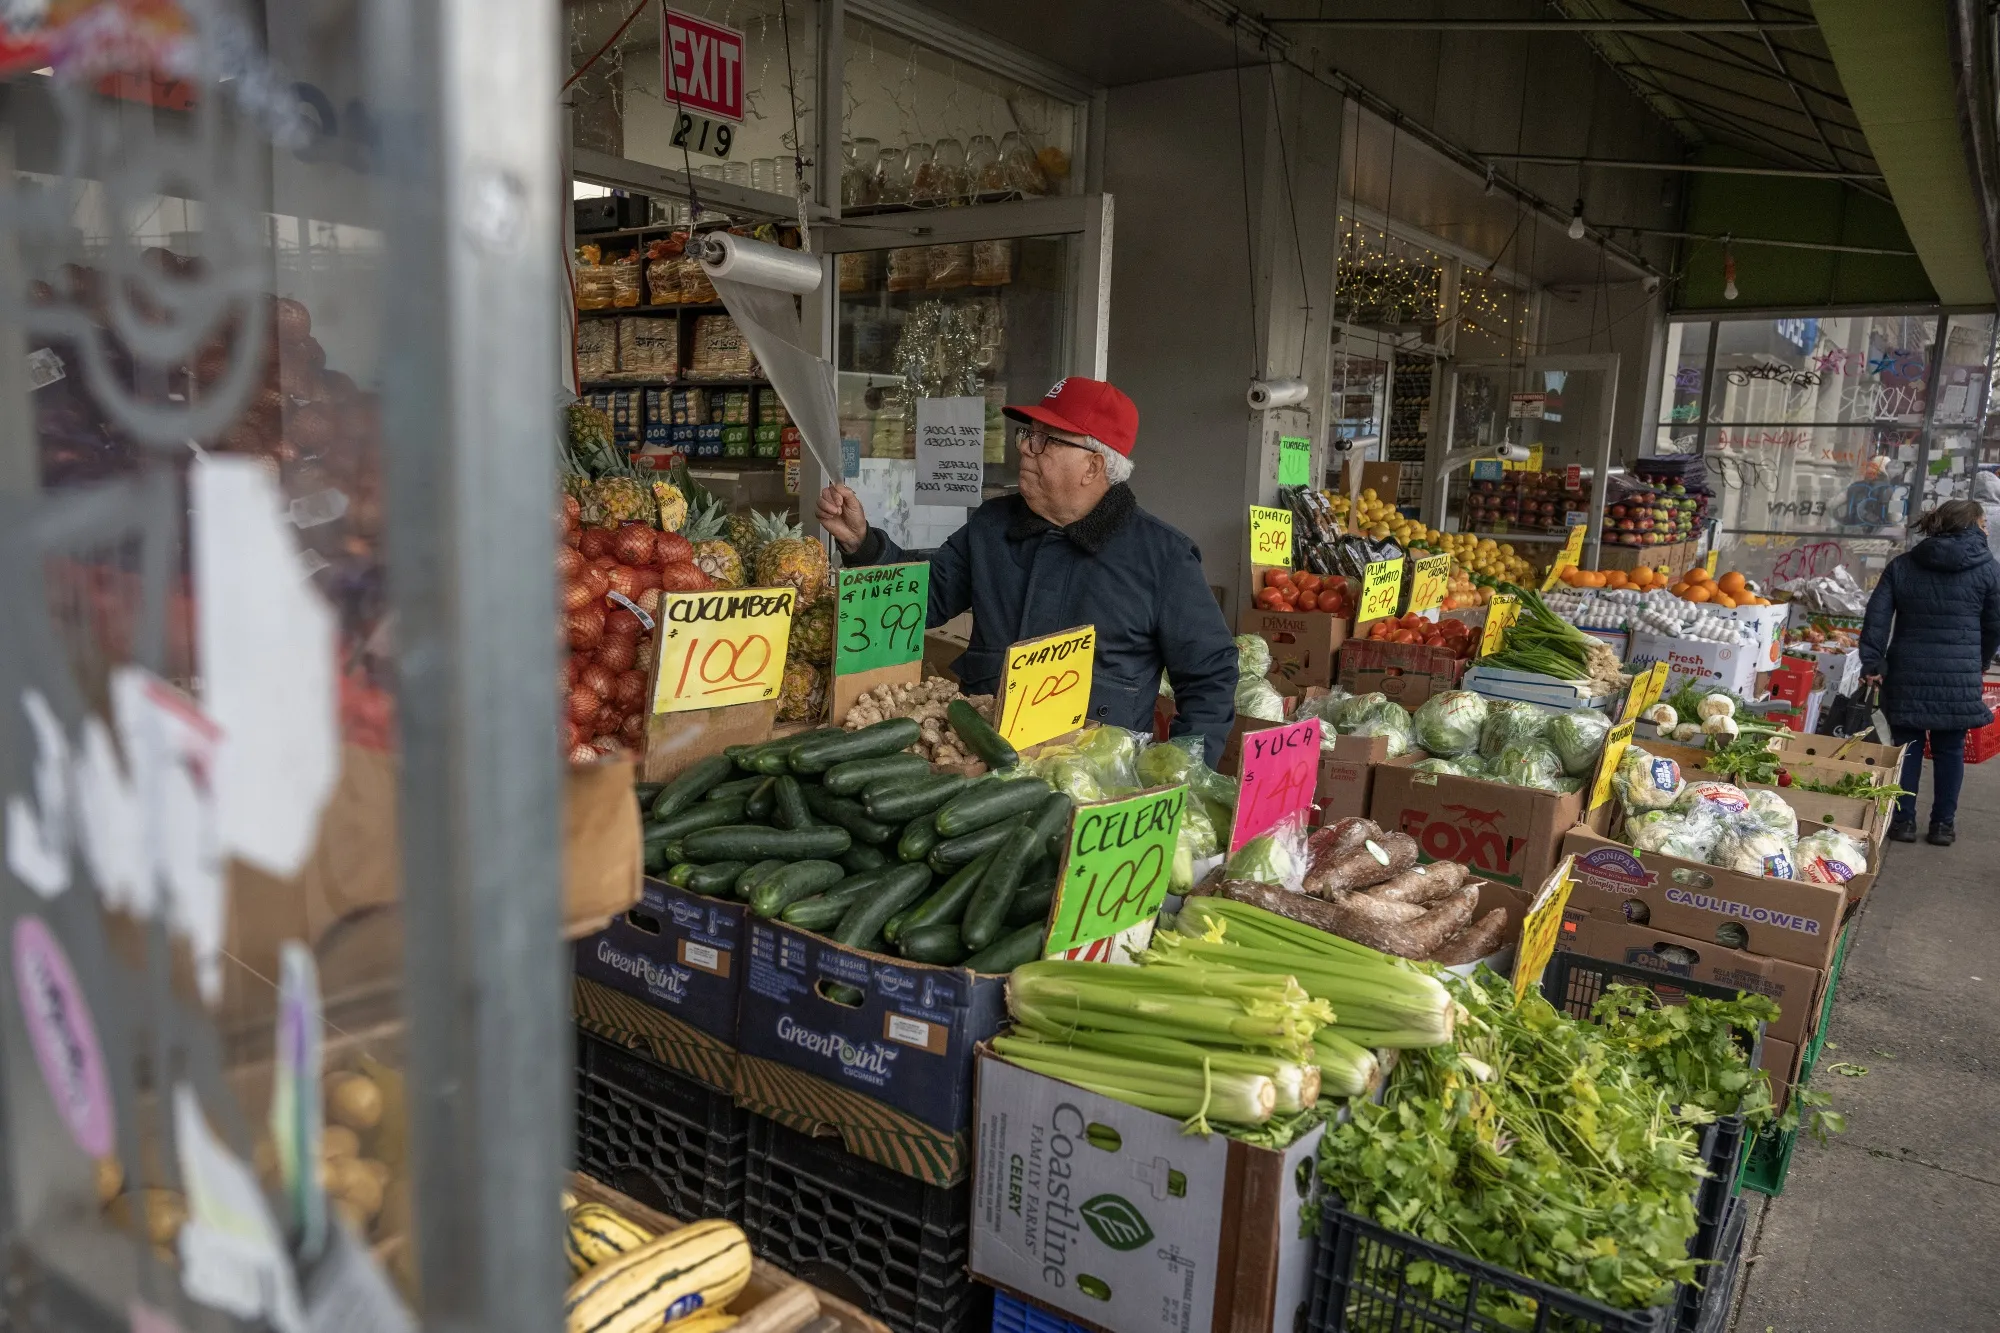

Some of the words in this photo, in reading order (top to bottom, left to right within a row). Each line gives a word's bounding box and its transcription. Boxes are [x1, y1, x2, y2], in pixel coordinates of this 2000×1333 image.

[668, 24, 739, 107] EXIT
[673, 114, 732, 157] 219
[1251, 509, 1291, 525] TOMATO
[1366, 561, 1387, 575] PLUM
[1417, 556, 1448, 573] BROCCOLI
[843, 568, 905, 587] ORGANIC
[1372, 569, 1400, 586] TOMATO
[842, 580, 919, 604] GINGER
[668, 593, 792, 623] CUCUMBER
[1011, 634, 1092, 670] CHAYOTE
[1668, 651, 1703, 665] Fresh
[1671, 664, 1713, 678] Garlic
[1254, 726, 1313, 759] YUCA
[1330, 766, 1357, 776] Iceberg
[1330, 773, 1357, 783] Lettuce
[1076, 792, 1183, 856] CELERY
[1401, 808, 1528, 874] FOXY
[1590, 851, 1639, 874] BONIPAK
[1828, 862, 1853, 880] BONIP
[1587, 875, 1614, 892] Simply
[1615, 883, 1638, 895] Fresh
[1665, 889, 1820, 934] CAULIFLOWER
[597, 940, 691, 994] GreenPoint
[839, 958, 867, 973] BUSHEL
[1639, 953, 1669, 969] Oak
[648, 986, 682, 1004] CUCUMBERS
[777, 1014, 899, 1075] GreenPoint
[843, 1066, 884, 1086] CUCUMBERS
[1028, 1123, 1043, 1185] FAMILY
[1008, 1153, 1024, 1218] CELERY
[1043, 1102, 1086, 1288] Coastline
[1183, 1268, 1195, 1302] STORAGE
